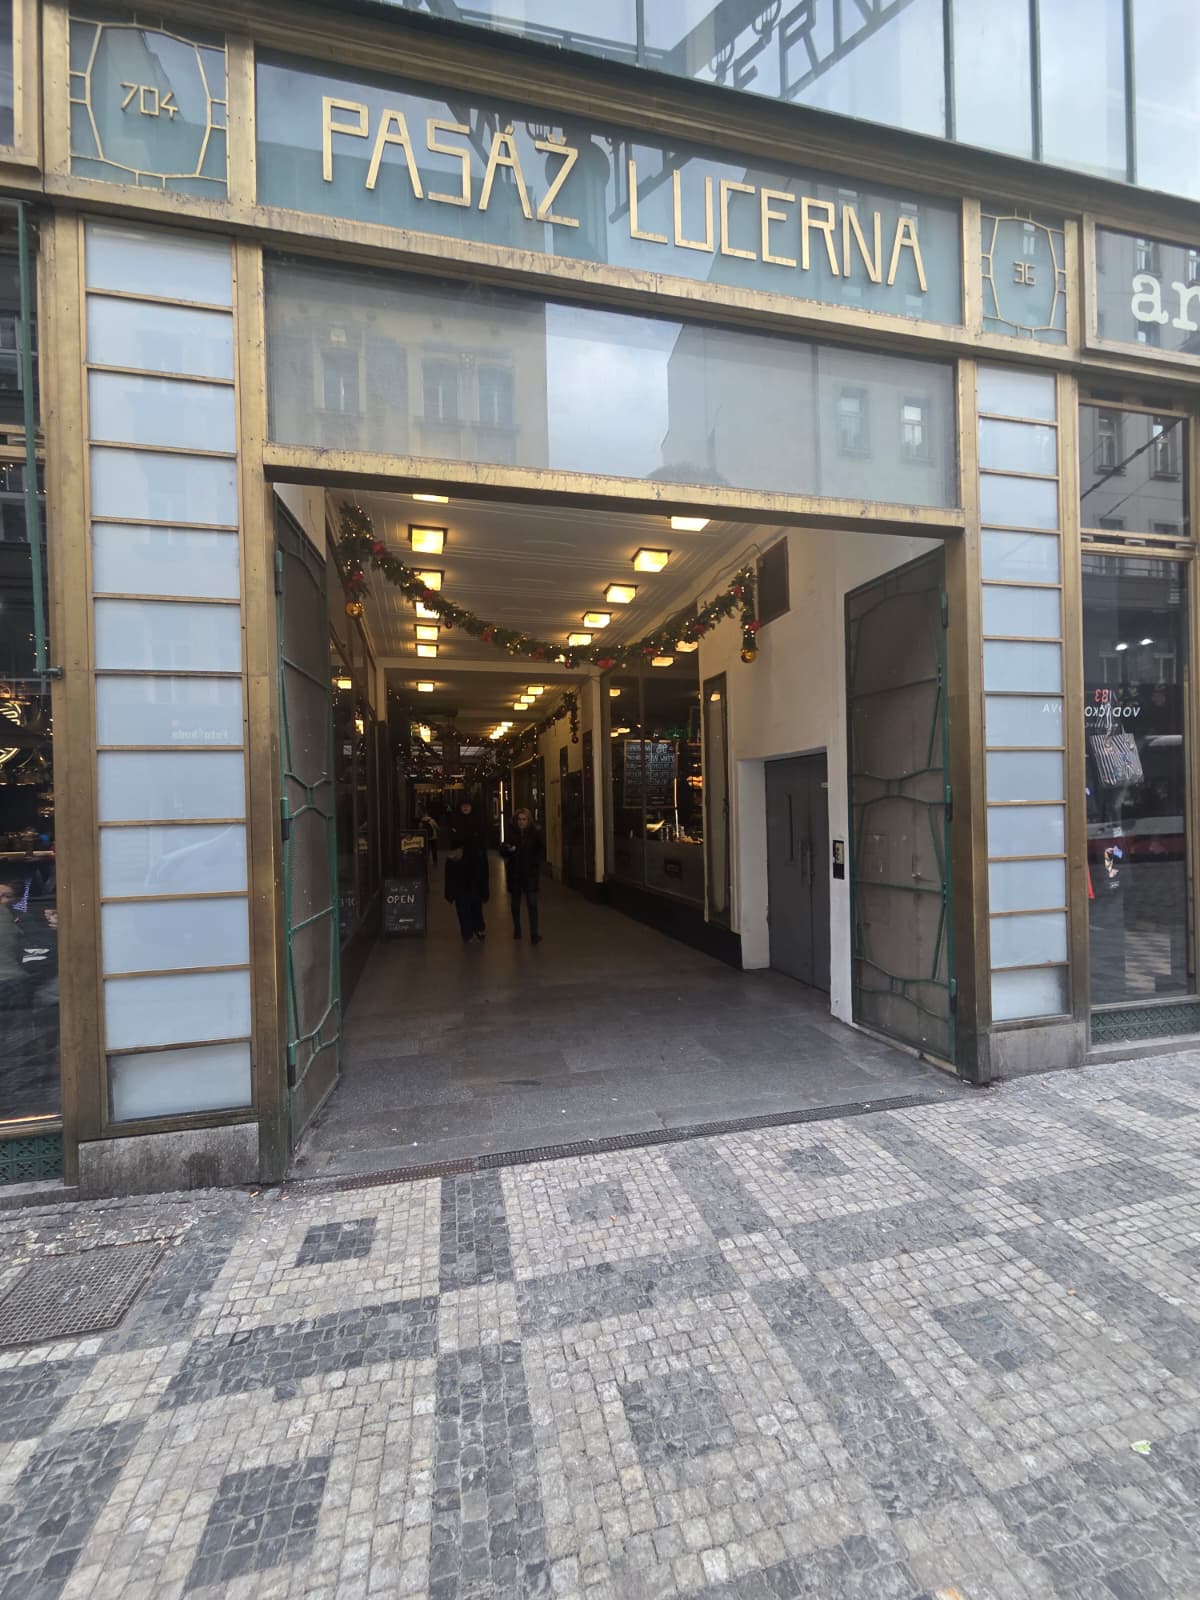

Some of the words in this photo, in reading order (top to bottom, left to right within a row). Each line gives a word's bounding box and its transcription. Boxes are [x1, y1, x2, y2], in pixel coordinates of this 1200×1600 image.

[120, 82, 179, 120] 704
[322, 96, 580, 227] PASÁŽ
[629, 160, 928, 292] LUCERNA
[1013, 260, 1037, 286] 36
[386, 894, 415, 904] OPEN
